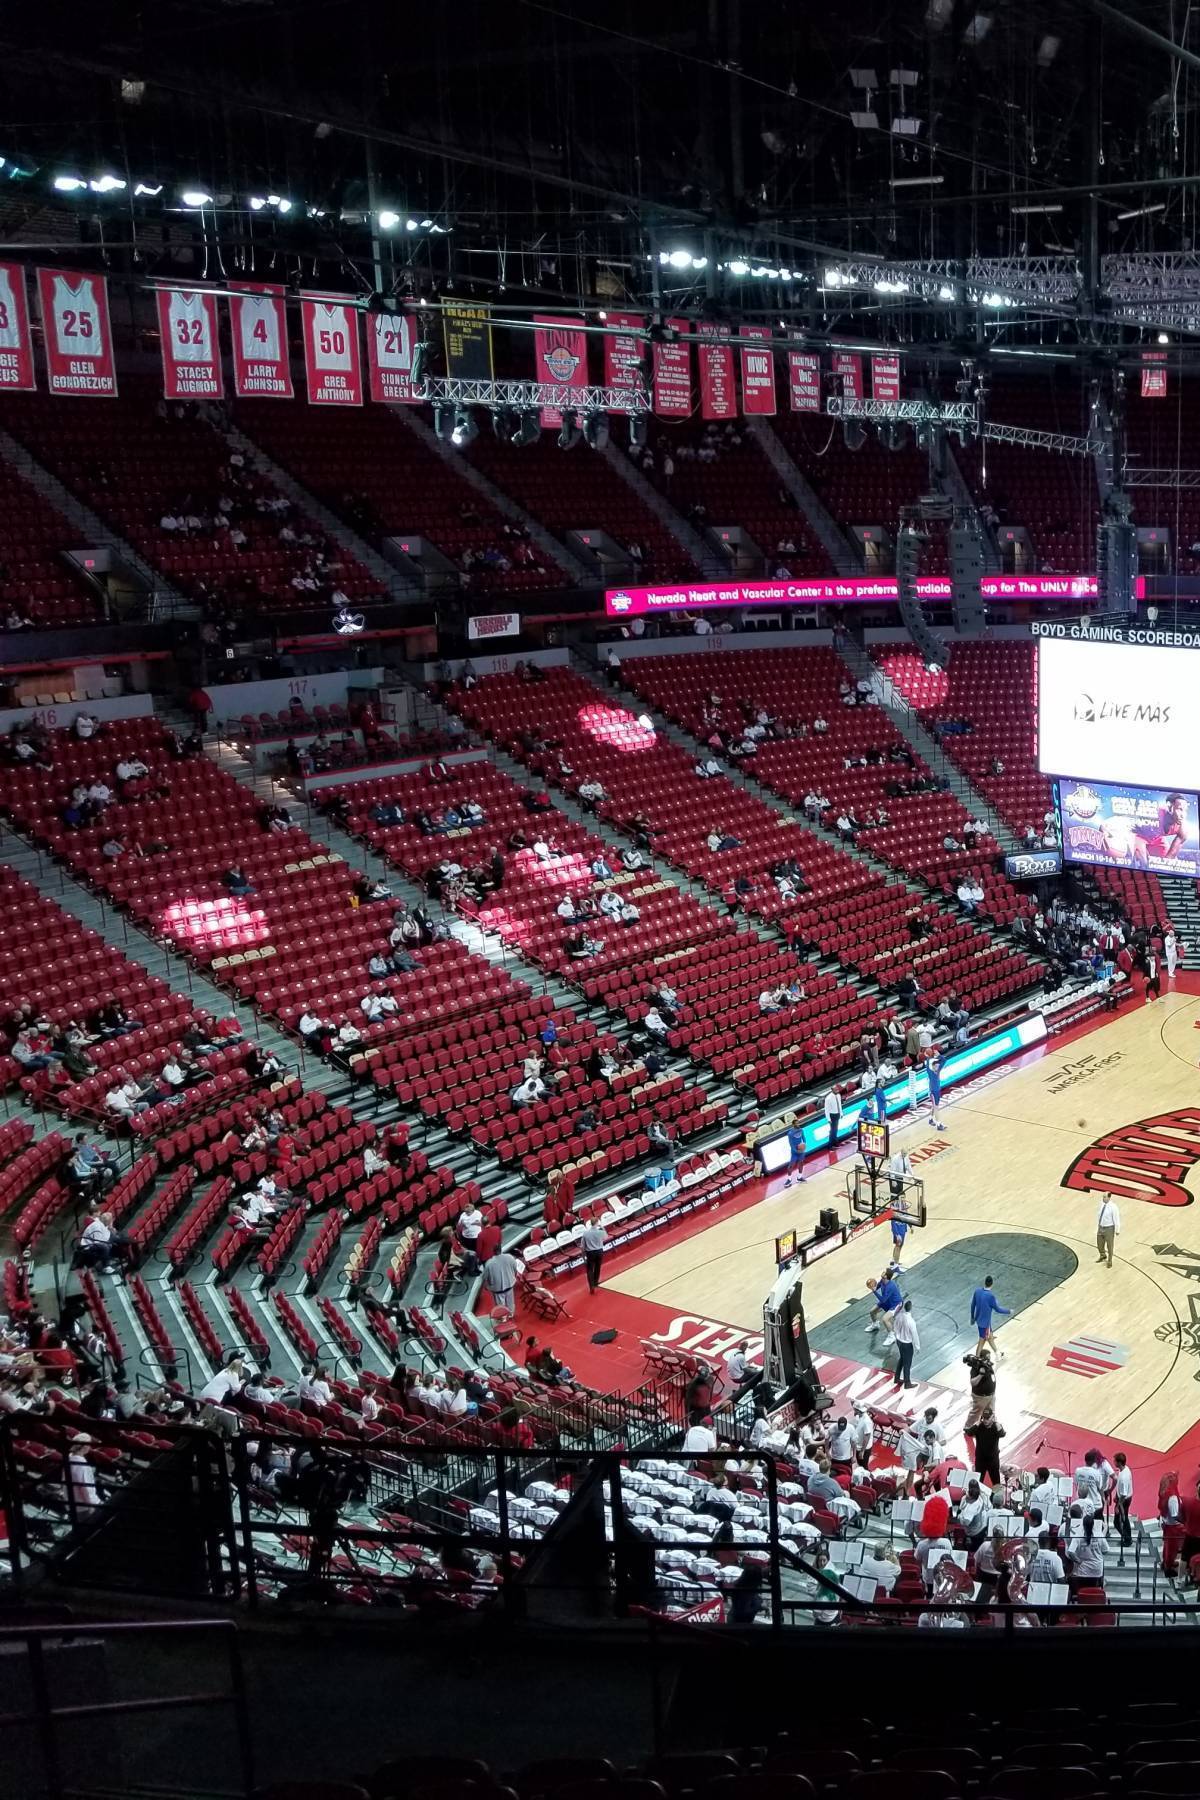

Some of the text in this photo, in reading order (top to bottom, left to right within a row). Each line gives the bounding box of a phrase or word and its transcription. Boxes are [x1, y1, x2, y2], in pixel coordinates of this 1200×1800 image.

[62, 310, 93, 337] 25
[177, 319, 203, 344] 32
[253, 319, 267, 343] 4
[320, 331, 345, 354] 50
[384, 331, 403, 354] 21
[70, 361, 95, 374] GLEN
[747, 356, 768, 373] MWC
[177, 366, 213, 379] STACEY
[248, 365, 277, 378] LARRY
[53, 375, 113, 389] GONDREZICK
[176, 380, 217, 392] AUGMON
[243, 378, 285, 391] JOHNSON
[324, 376, 346, 388] GREG
[381, 373, 409, 386] SIDNEY
[317, 389, 354, 400] ANTHONY
[384, 386, 409, 398] GREEN
[647, 594, 686, 604] Nevada
[688, 591, 716, 602] Heart
[719, 589, 739, 600] and
[742, 588, 784, 599] Vascular
[788, 586, 820, 597] Center
[825, 587, 832, 596] is
[837, 585, 853, 596] the
[856, 585, 897, 597] preferre
[1000, 582, 1016, 592] for
[1018, 582, 1037, 592] The
[1040, 582, 1068, 592] UNLV
[1031, 622, 1066, 637] BOYD
[1070, 625, 1123, 642] GAMING
[288, 680, 307, 695] 117
[1072, 851, 1094, 862] MARCH
[1015, 860, 1056, 873] BOYD
[1047, 1065, 1101, 1095] AMERICA
[1093, 1051, 1127, 1072] FIRST
